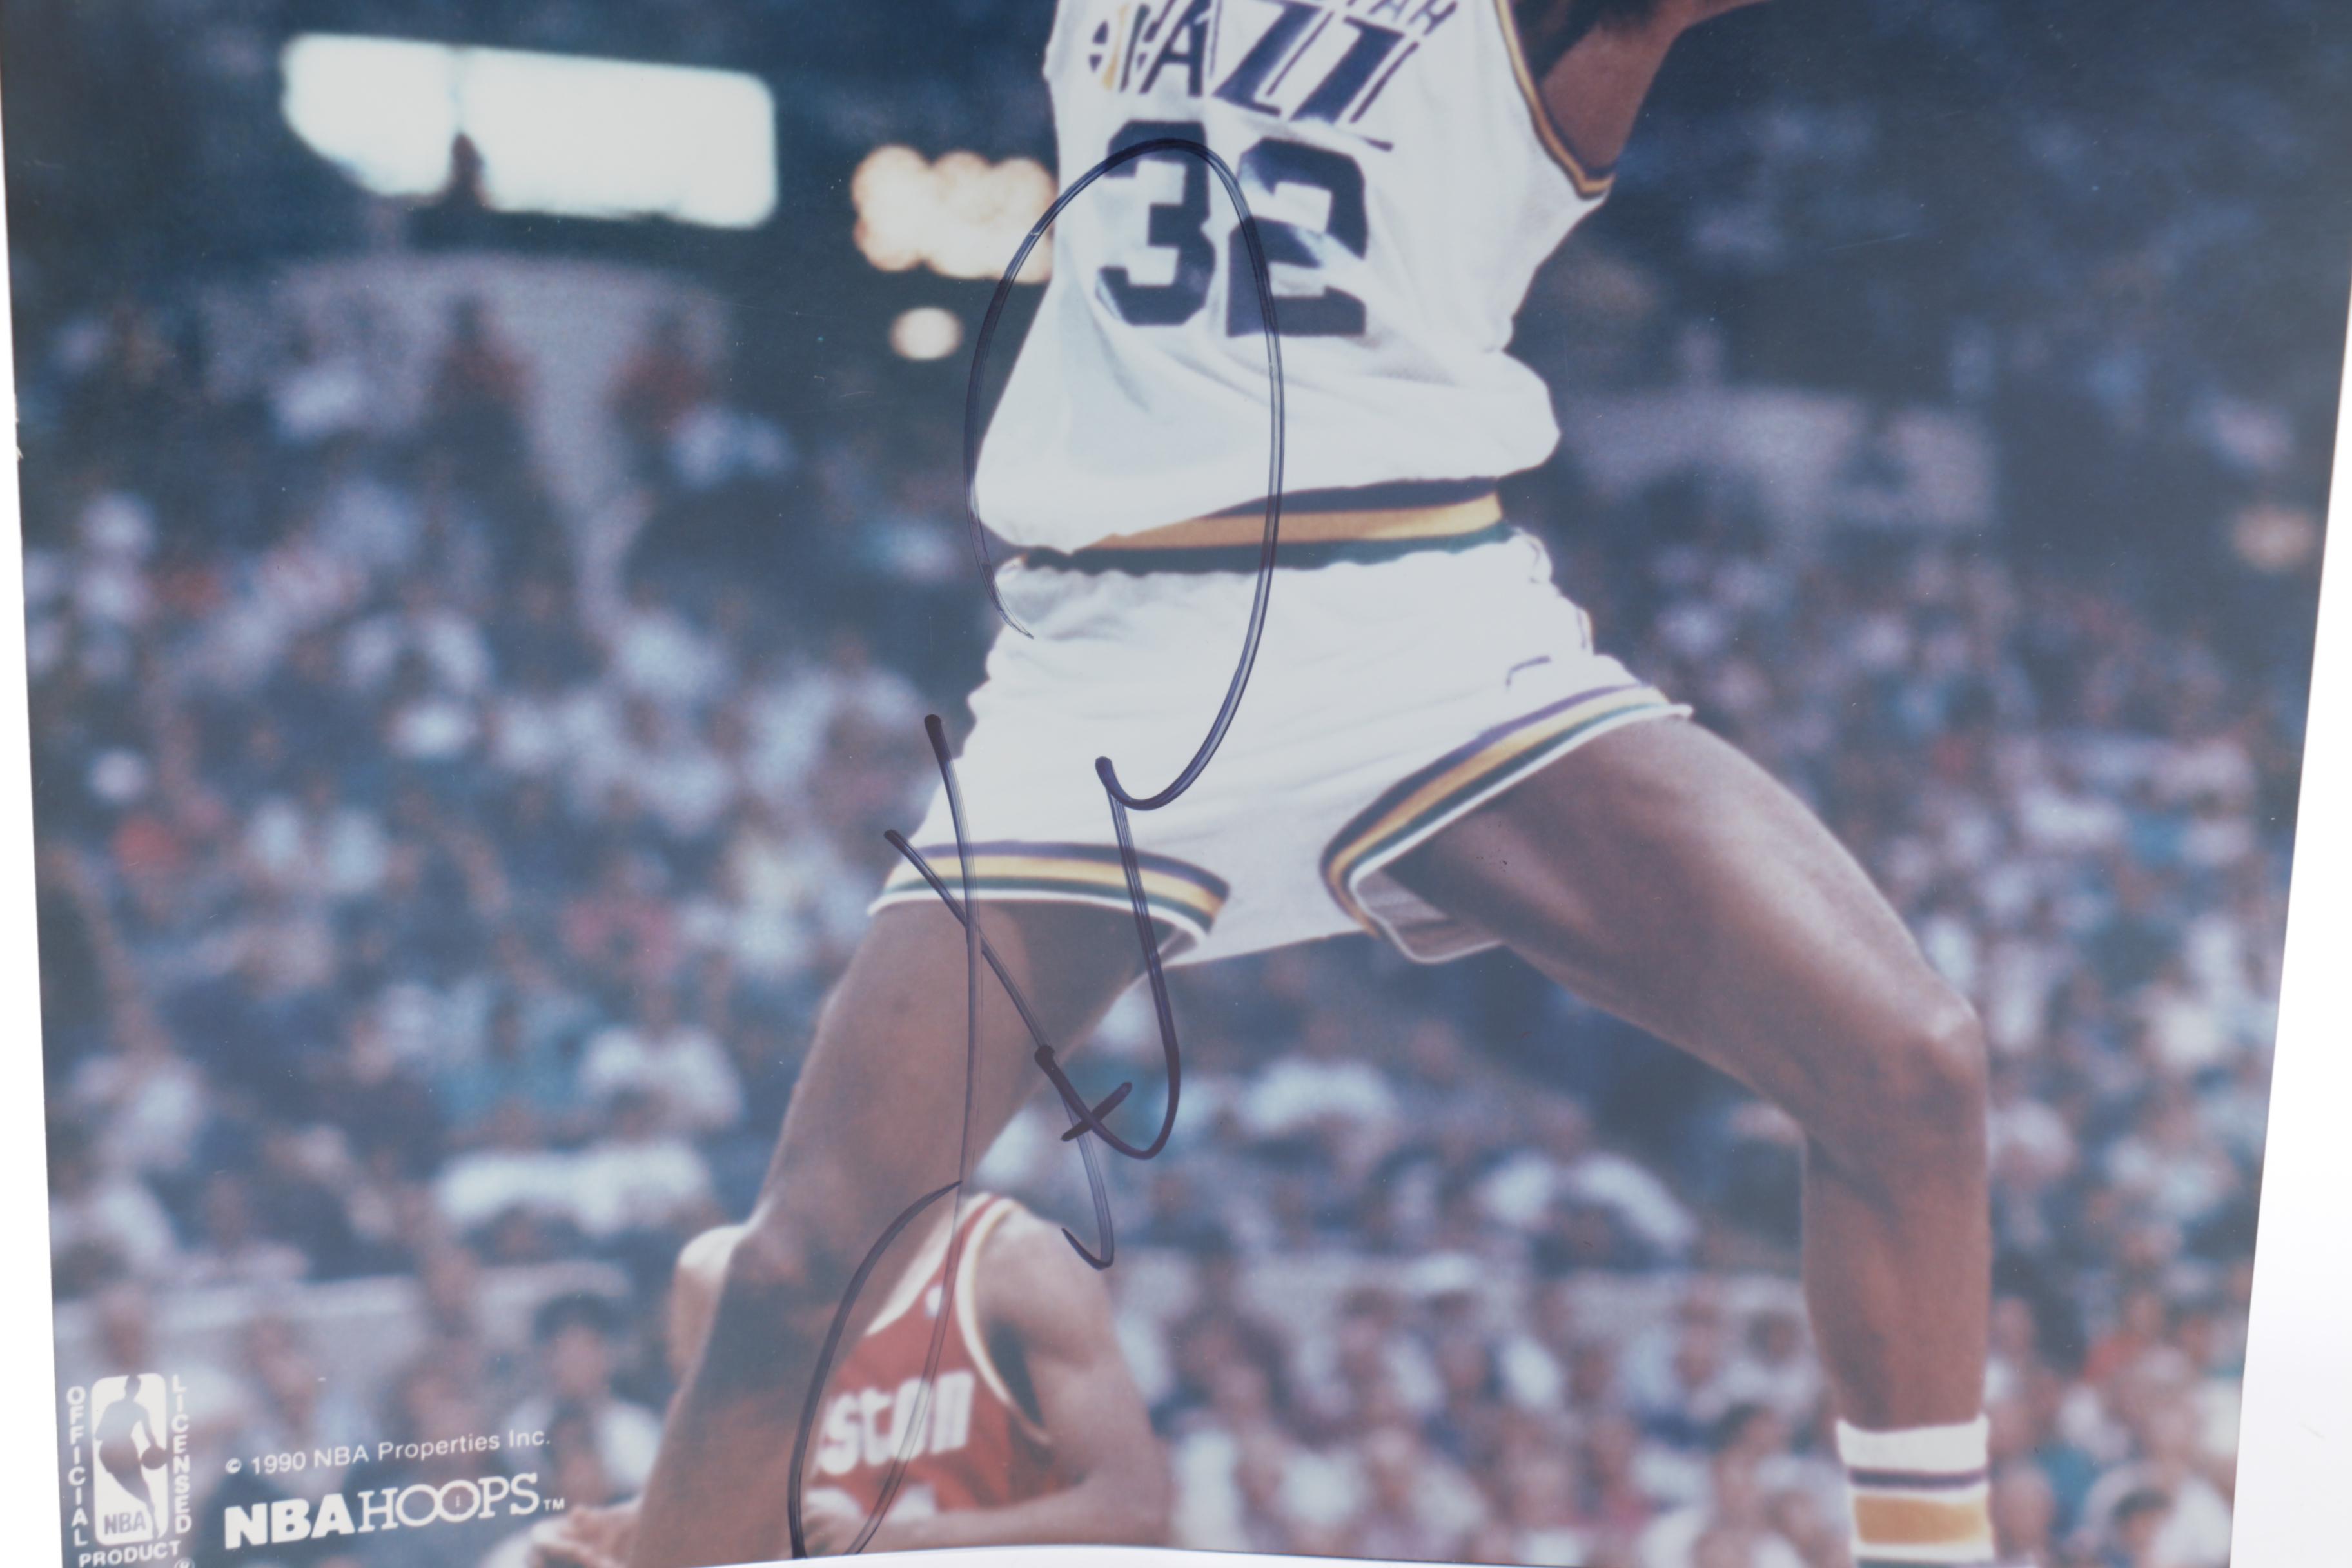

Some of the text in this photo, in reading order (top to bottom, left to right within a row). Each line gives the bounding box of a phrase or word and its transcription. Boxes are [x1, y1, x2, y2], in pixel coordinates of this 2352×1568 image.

[1095, 119, 1368, 338] 32
[66, 1386, 88, 1547] OFFICIAL
[172, 1374, 192, 1534] LICENSED
[251, 1452, 306, 1475] 1990
[313, 1445, 369, 1467] NBA
[378, 1433, 501, 1461] Properties
[509, 1429, 551, 1448] Inc.
[78, 1540, 181, 1568] PRODUCT
[104, 1511, 146, 1536] NBA
